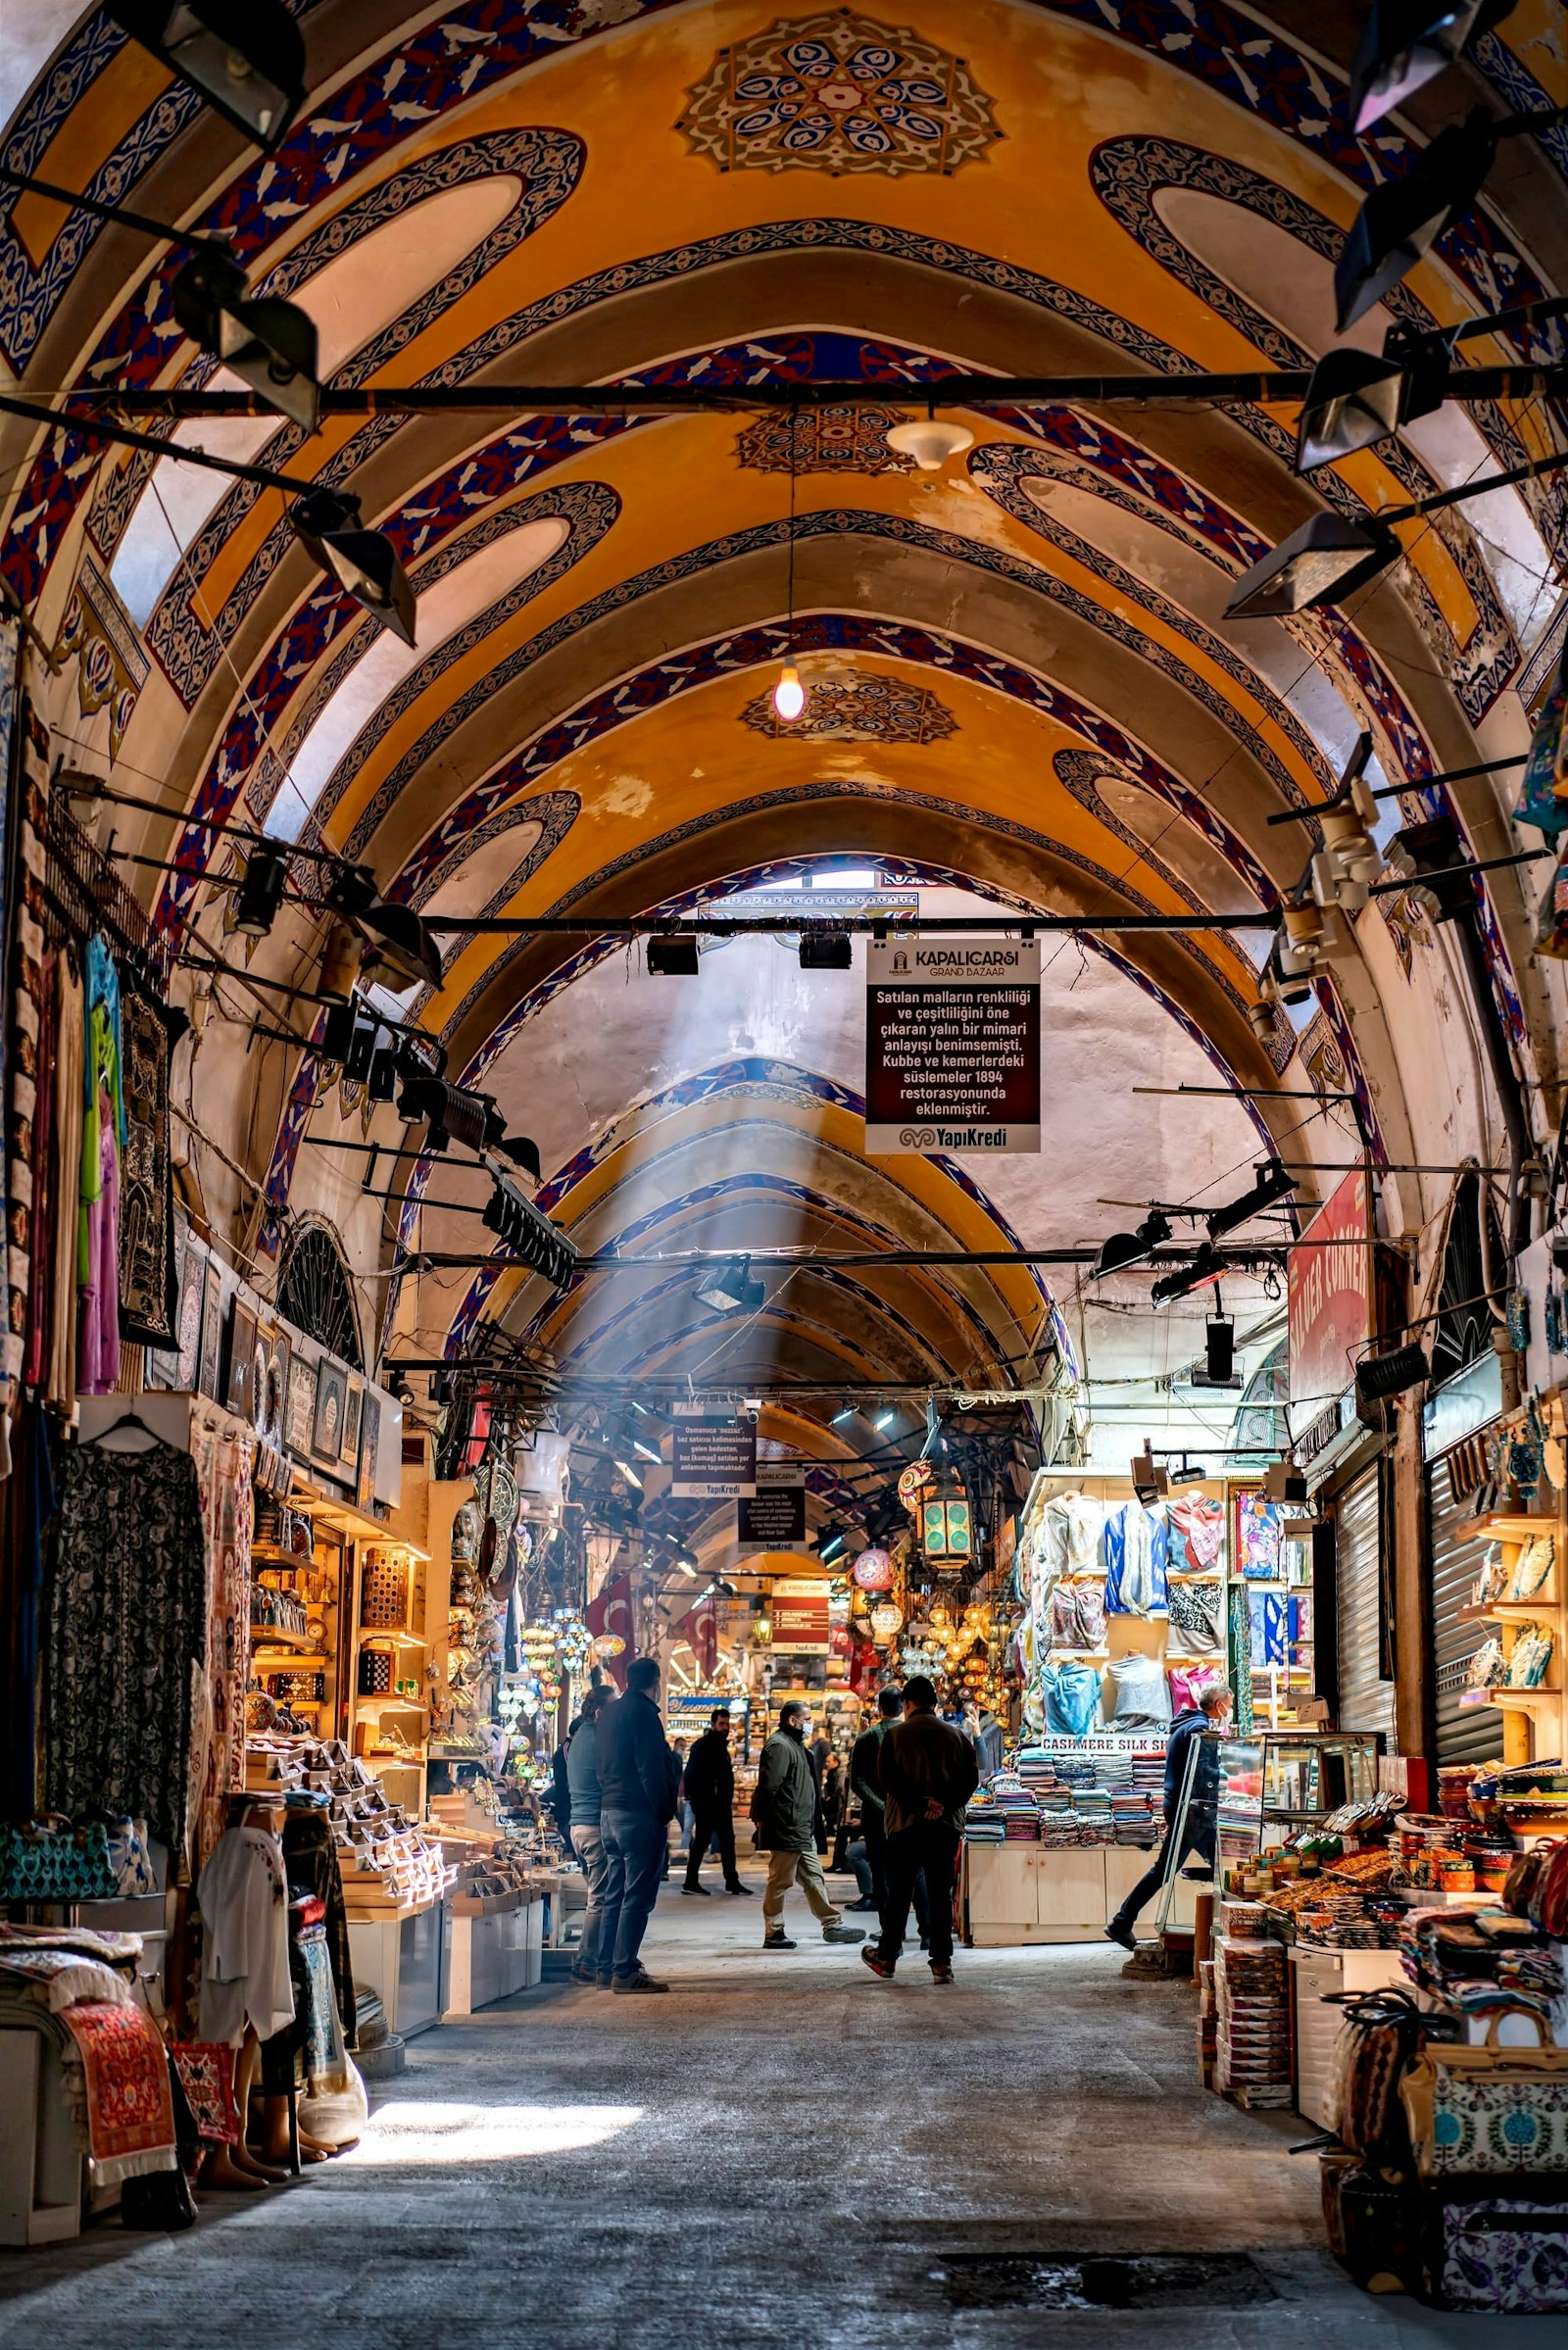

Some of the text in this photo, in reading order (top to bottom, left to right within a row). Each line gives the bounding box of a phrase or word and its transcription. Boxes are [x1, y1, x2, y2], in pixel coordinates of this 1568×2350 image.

[929, 967, 1005, 977] GRAND BAZAAR
[876, 990, 1031, 1005] Satılan malların renkliliği
[898, 1006, 1009, 1022] ve çeşitliliğini öne
[881, 1022, 1026, 1038] çıkaran yalın bir mimari
[884, 1038, 1022, 1054] anlayışı benimsemişti.
[883, 1054, 1024, 1067] Kubbe ve kemerlerdeki
[904, 1070, 1004, 1083] süslemeler 1894
[901, 1087, 1006, 1102] restorasyonunda
[916, 1102, 990, 1118] eklenmiştir.
[1325, 1223, 1366, 1299] CORNER
[1043, 1738, 1113, 1750] CASHMERE
[1118, 1739, 1148, 1750] SILK
